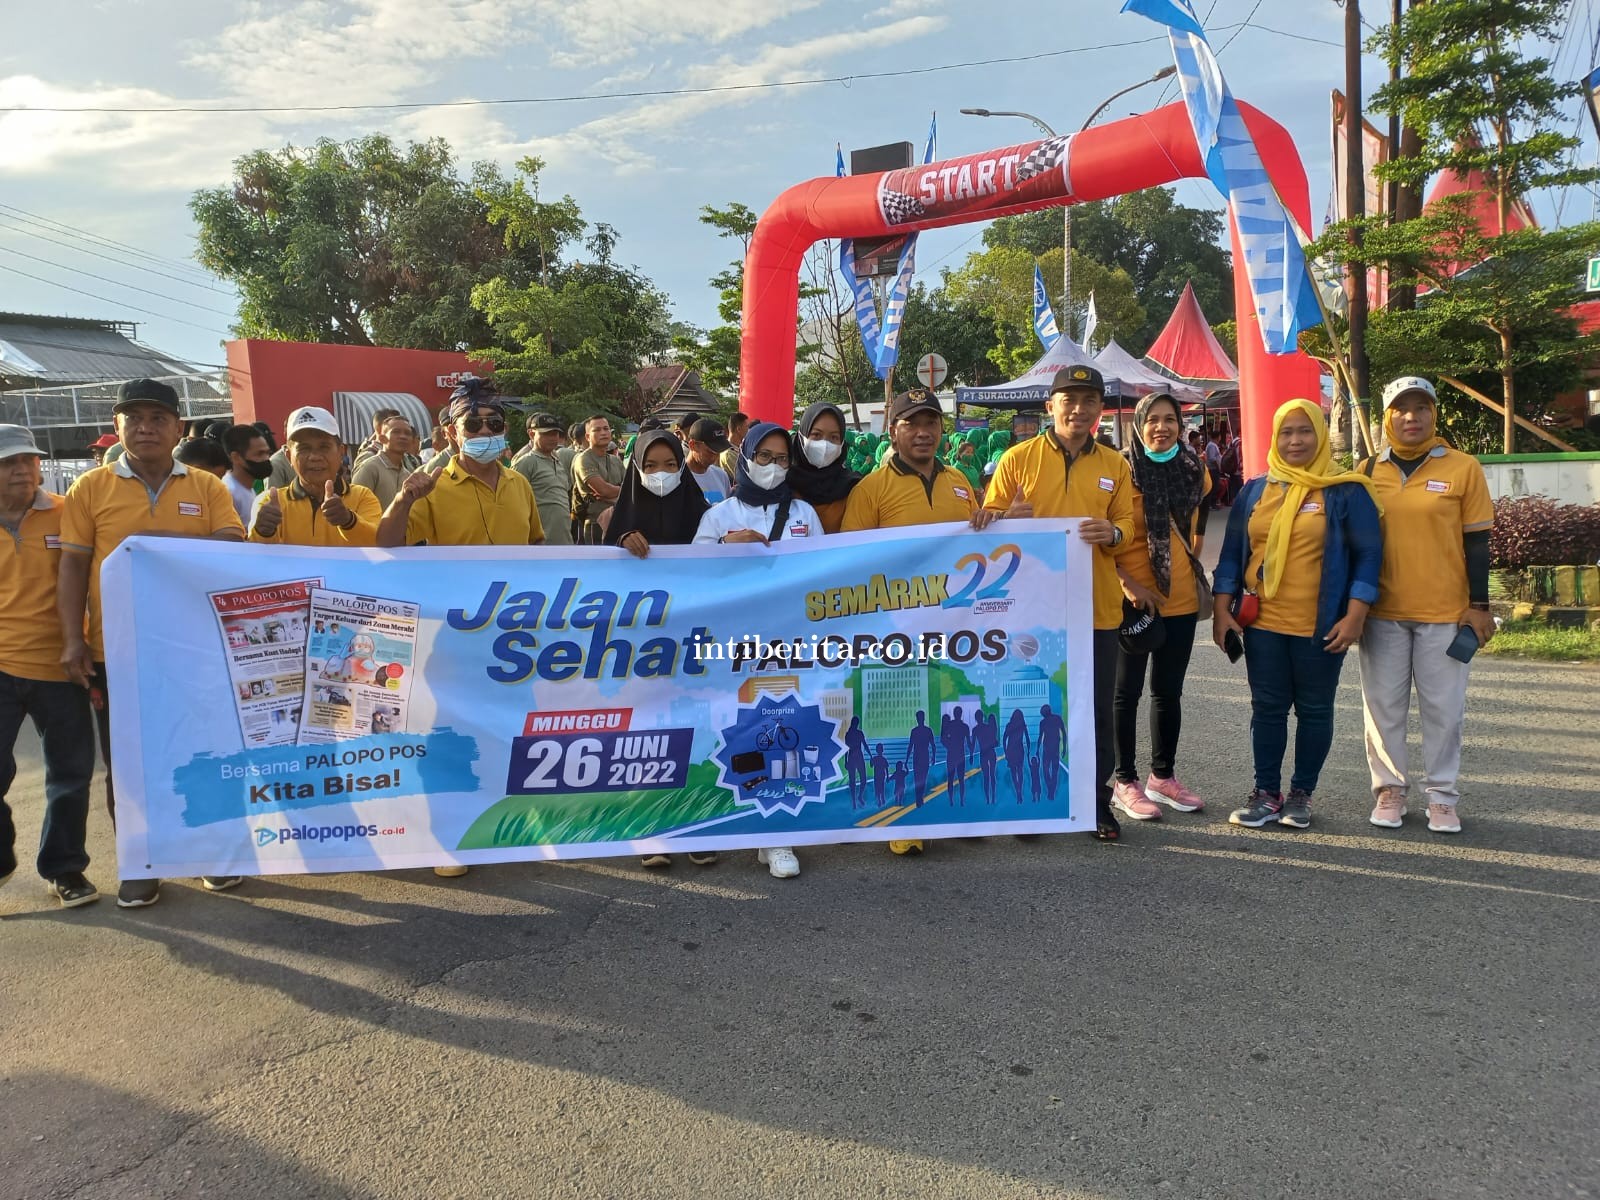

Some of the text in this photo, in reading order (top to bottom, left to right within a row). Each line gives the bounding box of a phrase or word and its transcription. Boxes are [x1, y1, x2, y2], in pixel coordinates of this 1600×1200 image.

[919, 154, 1021, 206] START
[232, 587, 302, 606] PALOPO POS
[805, 543, 1022, 621] SEMARAK 22
[313, 611, 334, 620] Target
[358, 618, 372, 626] dari
[373, 621, 390, 629] Zona
[332, 597, 375, 612] PALOPO
[377, 604, 398, 615] POS
[447, 578, 671, 631] Jalan
[486, 617, 713, 683] Sehat
[731, 632, 913, 672] PALOPO
[531, 713, 622, 732] MINGGU
[761, 707, 795, 716] Doorprize
[221, 745, 427, 779] Bersama PALOPO POS
[522, 738, 603, 789] 26
[611, 735, 670, 760] JUNI
[250, 769, 400, 803] Kita Bisa!
[608, 760, 677, 786] 2022
